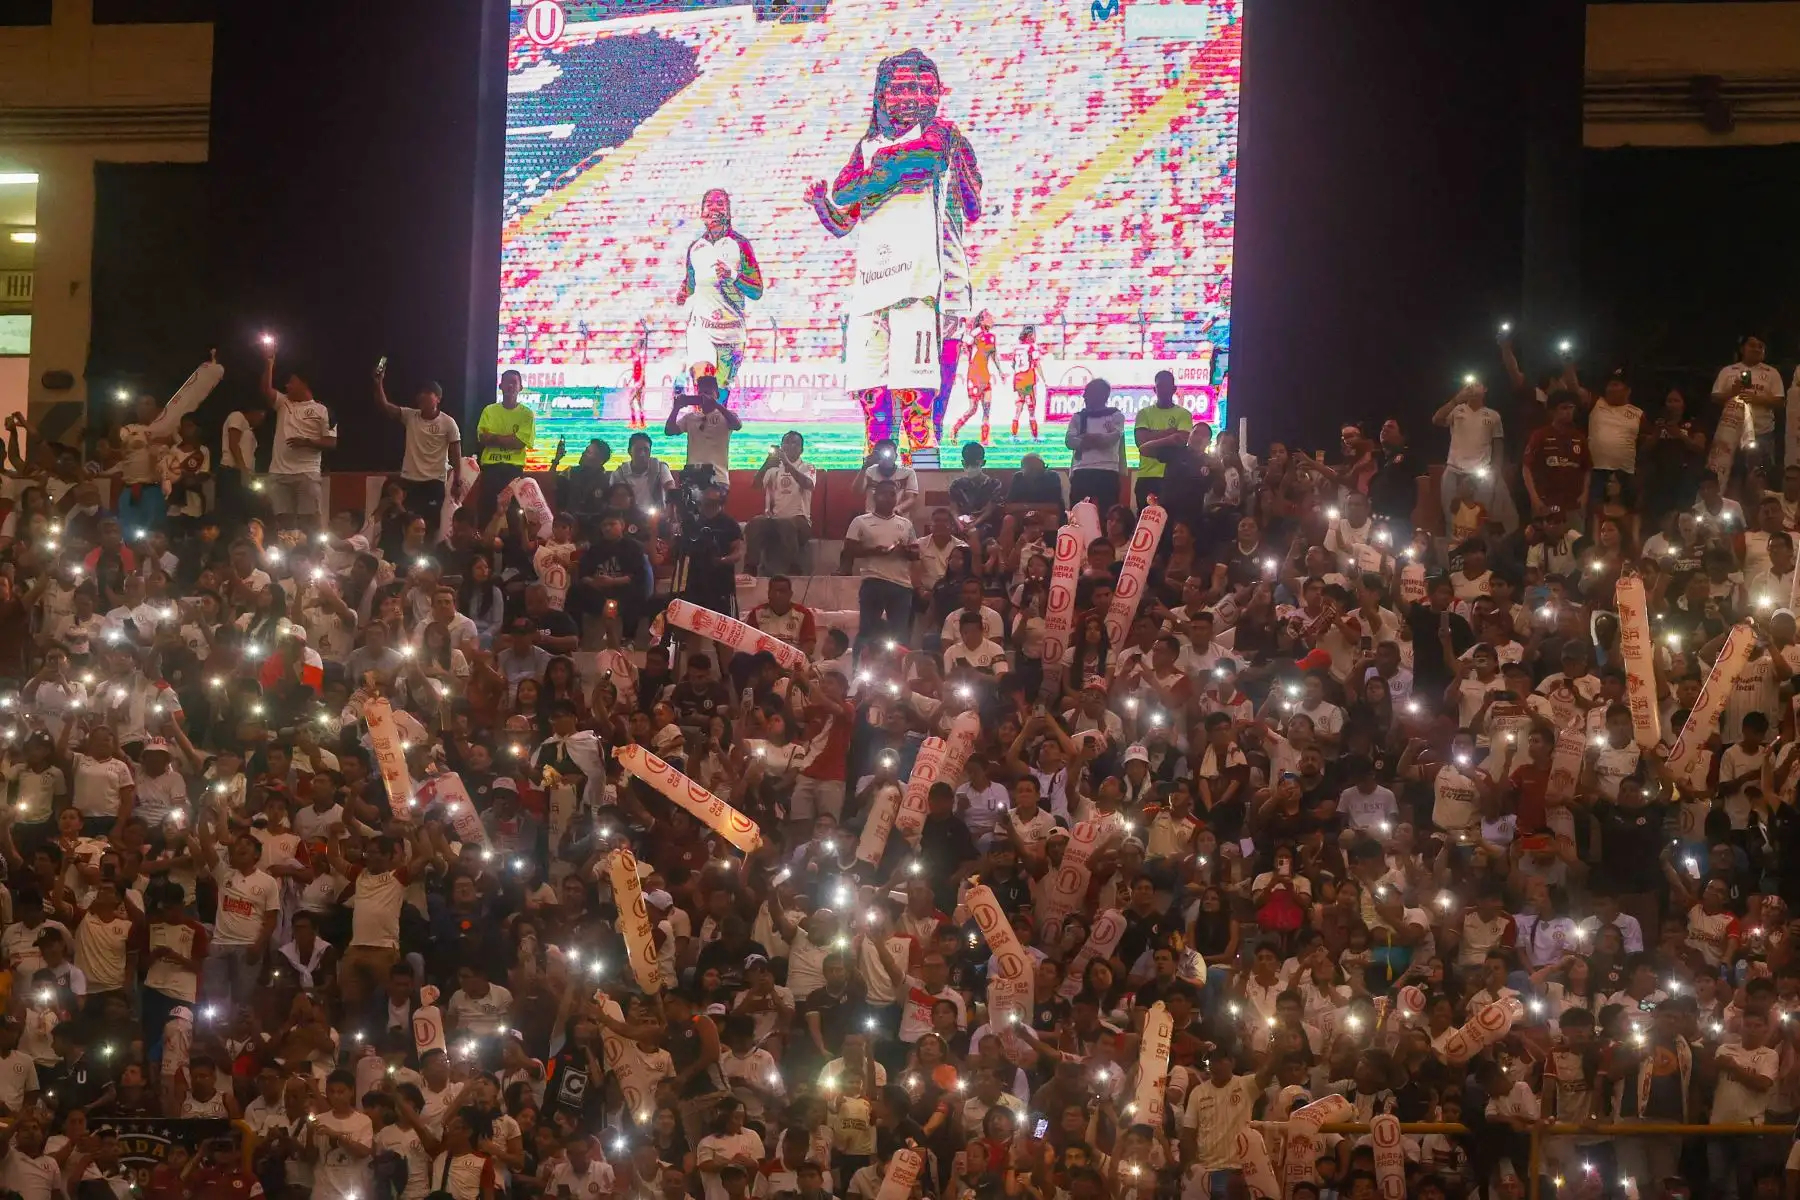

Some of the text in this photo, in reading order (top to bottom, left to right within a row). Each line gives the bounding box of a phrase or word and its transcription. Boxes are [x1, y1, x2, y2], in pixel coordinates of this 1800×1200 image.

[535, 8, 557, 41] U
[914, 330, 932, 364] 11
[1141, 514, 1160, 524] REMA
[1143, 509, 1162, 518] ARRA
[1057, 539, 1073, 558] U
[1132, 531, 1150, 550] U
[1053, 565, 1074, 573] ARRA
[1125, 561, 1145, 572] REMA
[1126, 555, 1146, 564] ARRA
[1116, 577, 1135, 597] U
[1050, 590, 1065, 610] U
[1110, 602, 1130, 612] ARRA
[1045, 622, 1066, 631] REMA
[1046, 616, 1067, 625] ARRA
[1044, 642, 1058, 661] U
[987, 798, 996, 812] U
[1009, 887, 1018, 900] U
[1730, 884, 1740, 900] U
[975, 907, 994, 930] U
[1094, 921, 1112, 941] U
[1002, 956, 1018, 978] U
[1480, 1006, 1502, 1026] U
[414, 1022, 430, 1044] U
[76, 1070, 88, 1084] U
[564, 1074, 585, 1094] C
[1378, 1121, 1396, 1145] U
[120, 1140, 165, 1158] ADA
[1383, 1179, 1402, 1200] U
